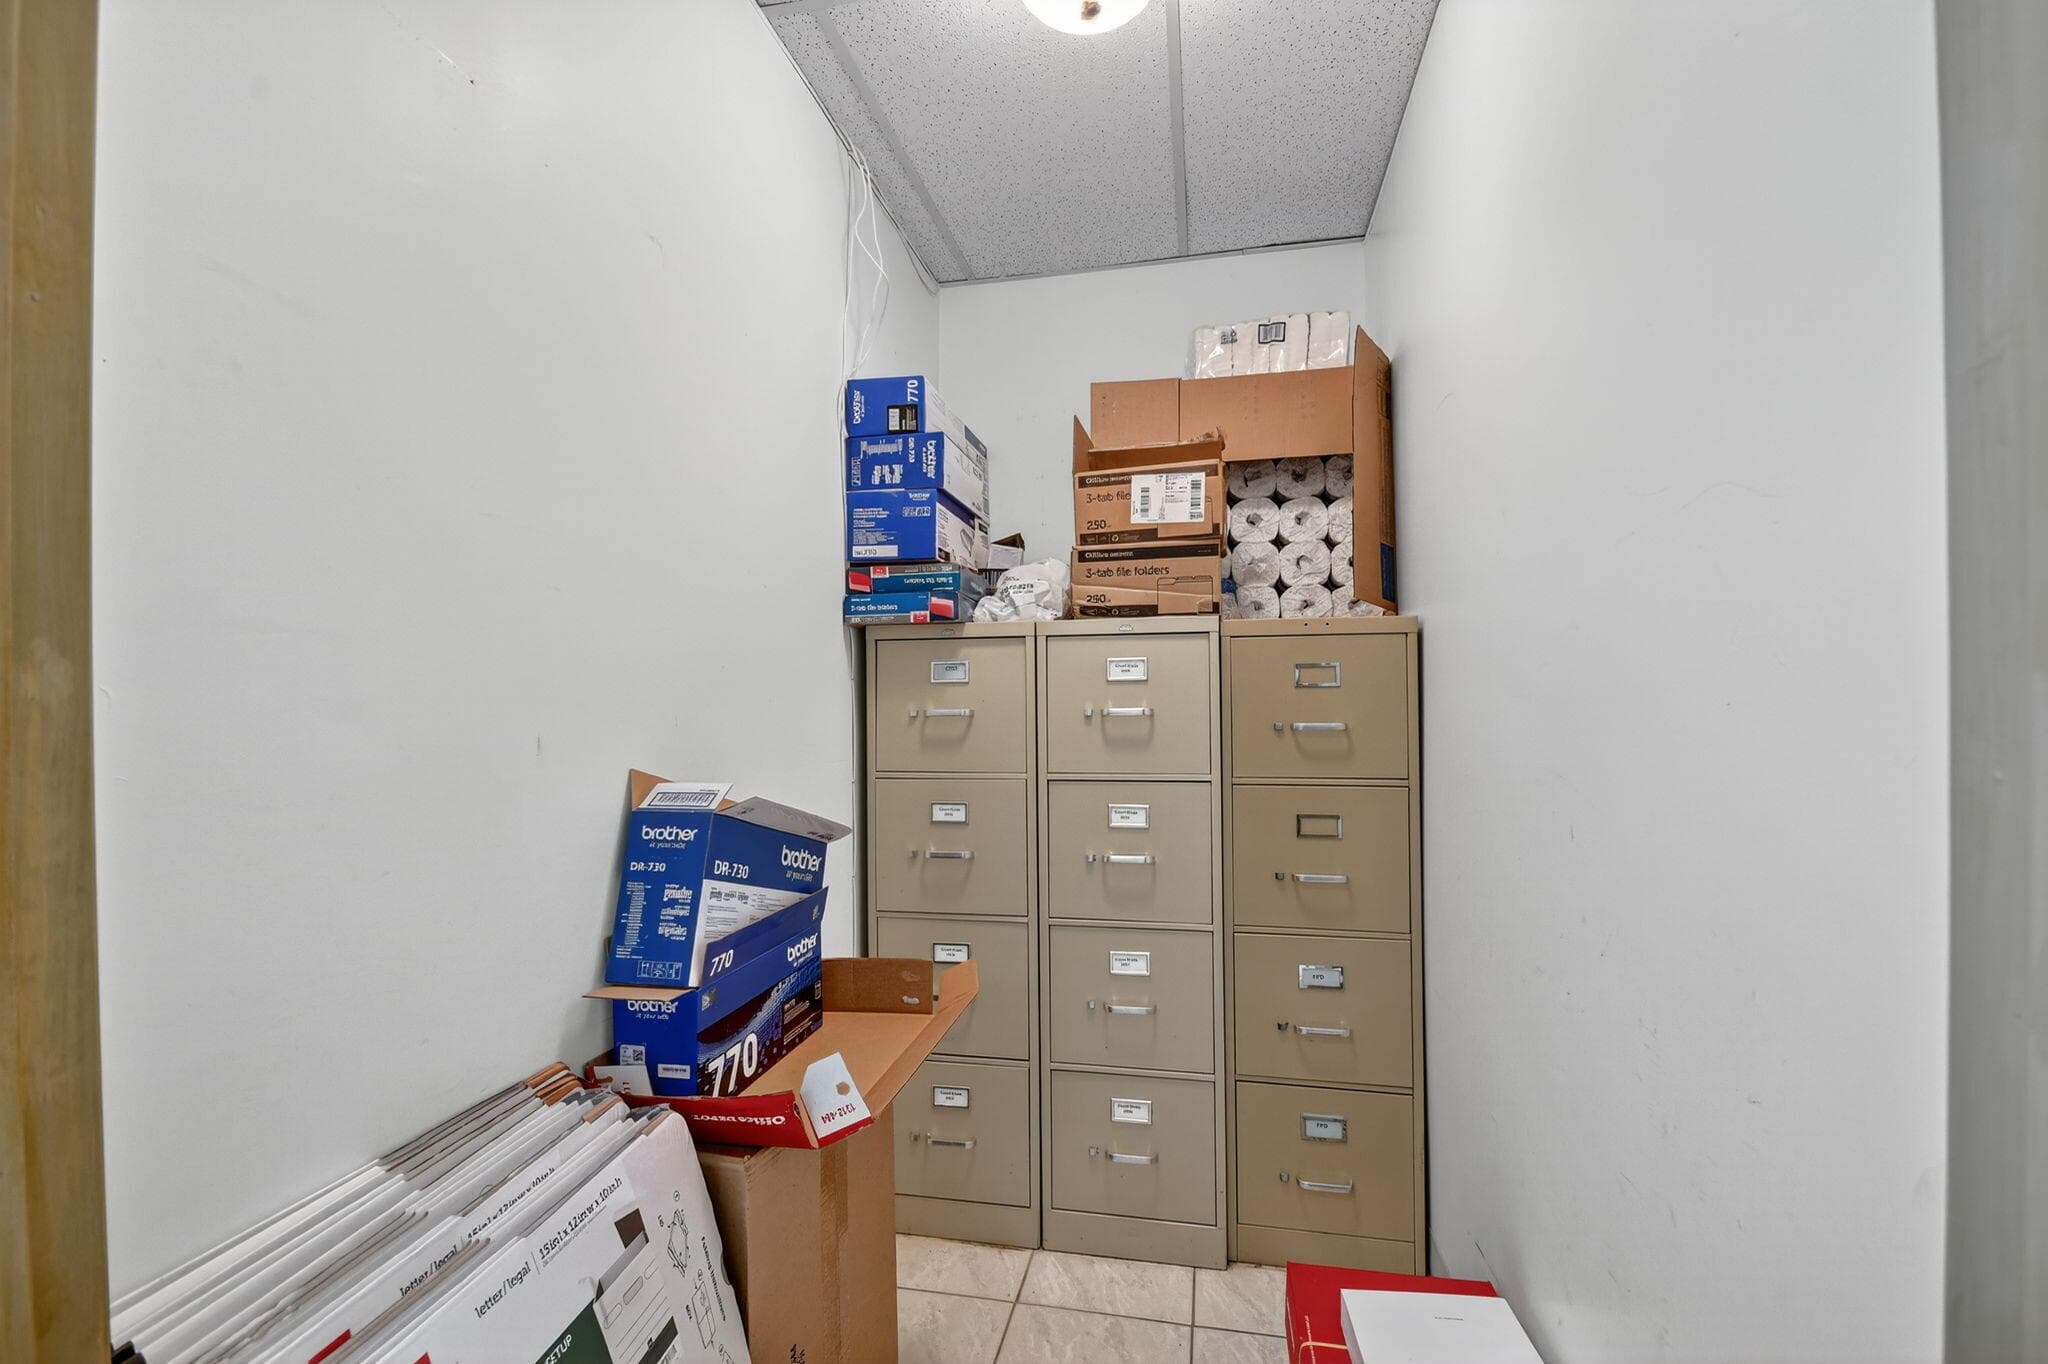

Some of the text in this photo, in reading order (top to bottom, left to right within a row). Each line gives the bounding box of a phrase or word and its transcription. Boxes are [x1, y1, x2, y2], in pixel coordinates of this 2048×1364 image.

[907, 379, 919, 403] 770
[1086, 493, 1114, 504] 3-tab
[1085, 565, 1170, 579] 3-tab file folders
[641, 824, 698, 841] brother
[630, 861, 666, 872] DR-730
[713, 860, 749, 879] DR-730
[781, 844, 822, 872] brother
[787, 932, 818, 962] brother
[709, 949, 734, 977] 770
[707, 1032, 759, 1097] 770
[475, 1261, 531, 1319] letter/legal
